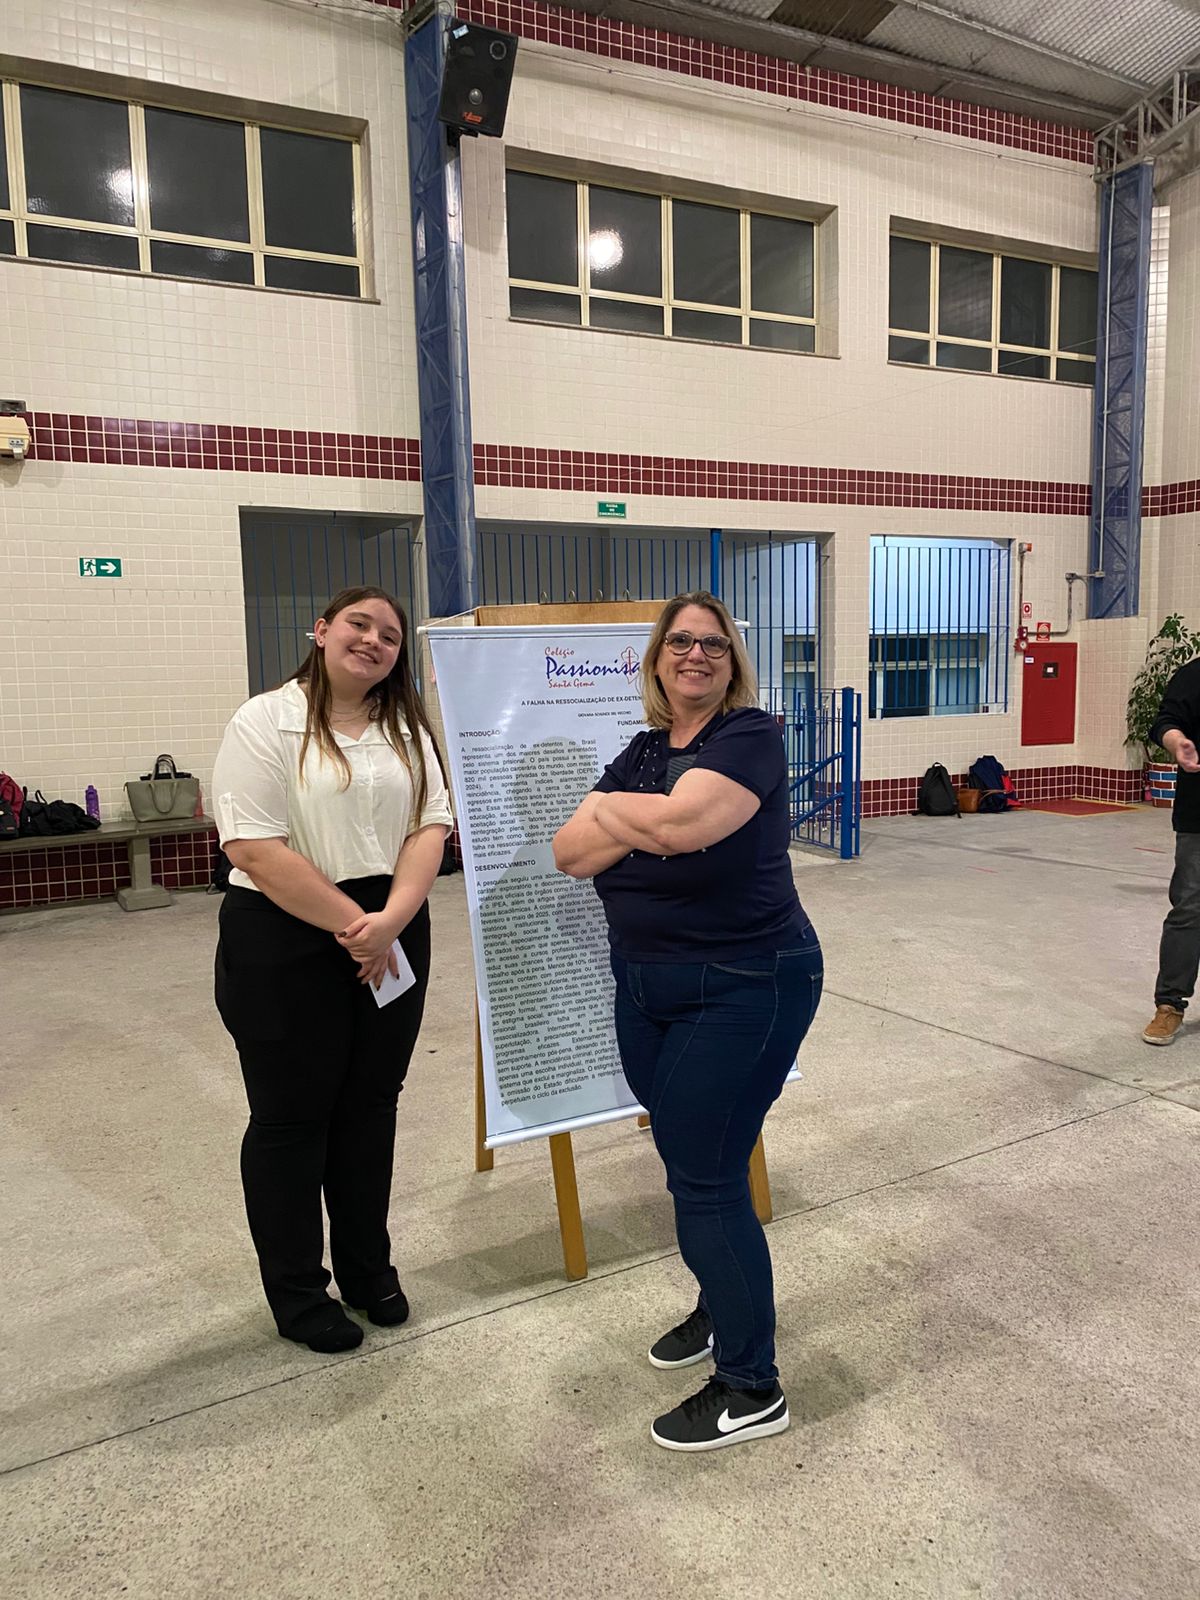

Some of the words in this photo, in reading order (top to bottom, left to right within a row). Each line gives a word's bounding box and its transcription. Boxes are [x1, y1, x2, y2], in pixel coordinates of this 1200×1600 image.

[548, 679, 572, 688] Santa
[573, 678, 595, 688] Gema
[555, 697, 607, 705] RESSOCIALIZAÇÃO
[459, 730, 501, 738] INTRODUÇÃO
[475, 860, 536, 871] DESENVOLVIMENTO
